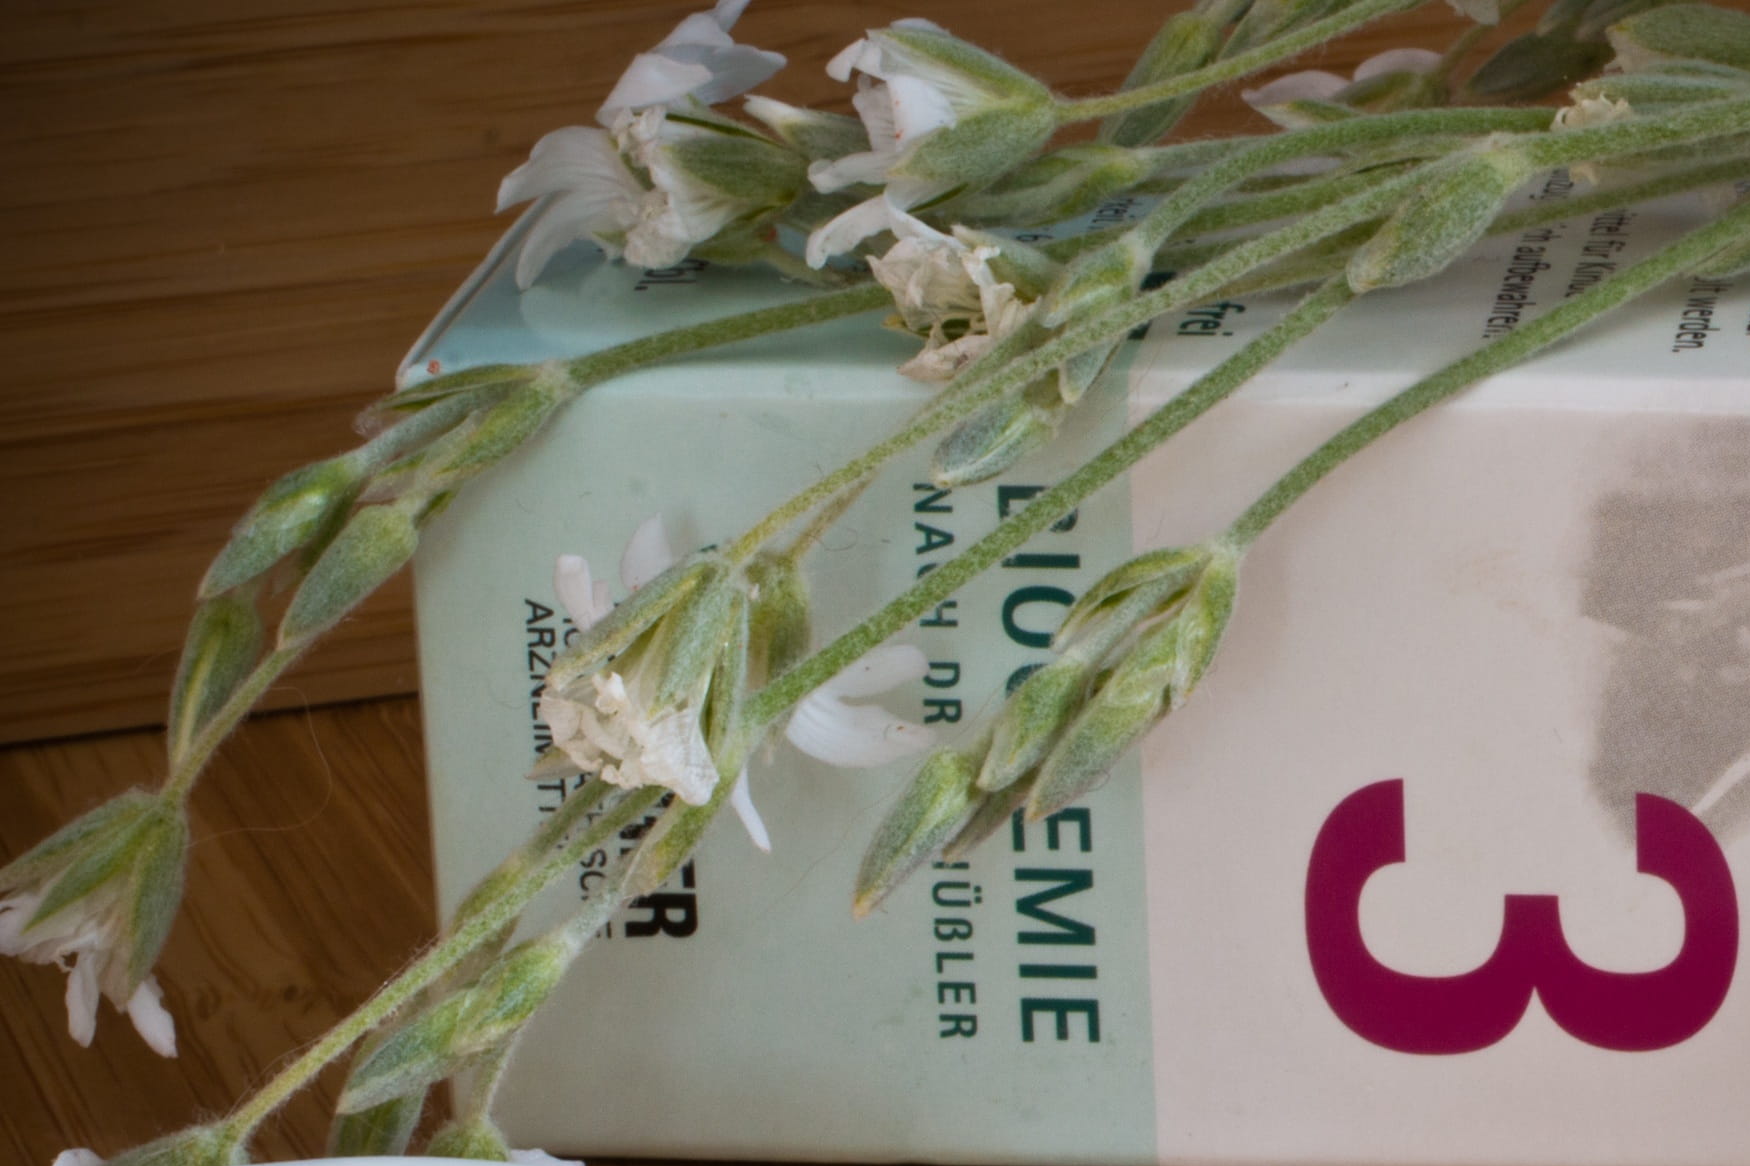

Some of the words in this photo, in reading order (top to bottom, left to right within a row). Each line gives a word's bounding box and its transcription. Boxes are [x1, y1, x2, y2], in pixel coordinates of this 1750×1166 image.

[1581, 239, 1626, 259] für
[1671, 296, 1721, 353] werden.
[1304, 778, 1740, 1056] 3
